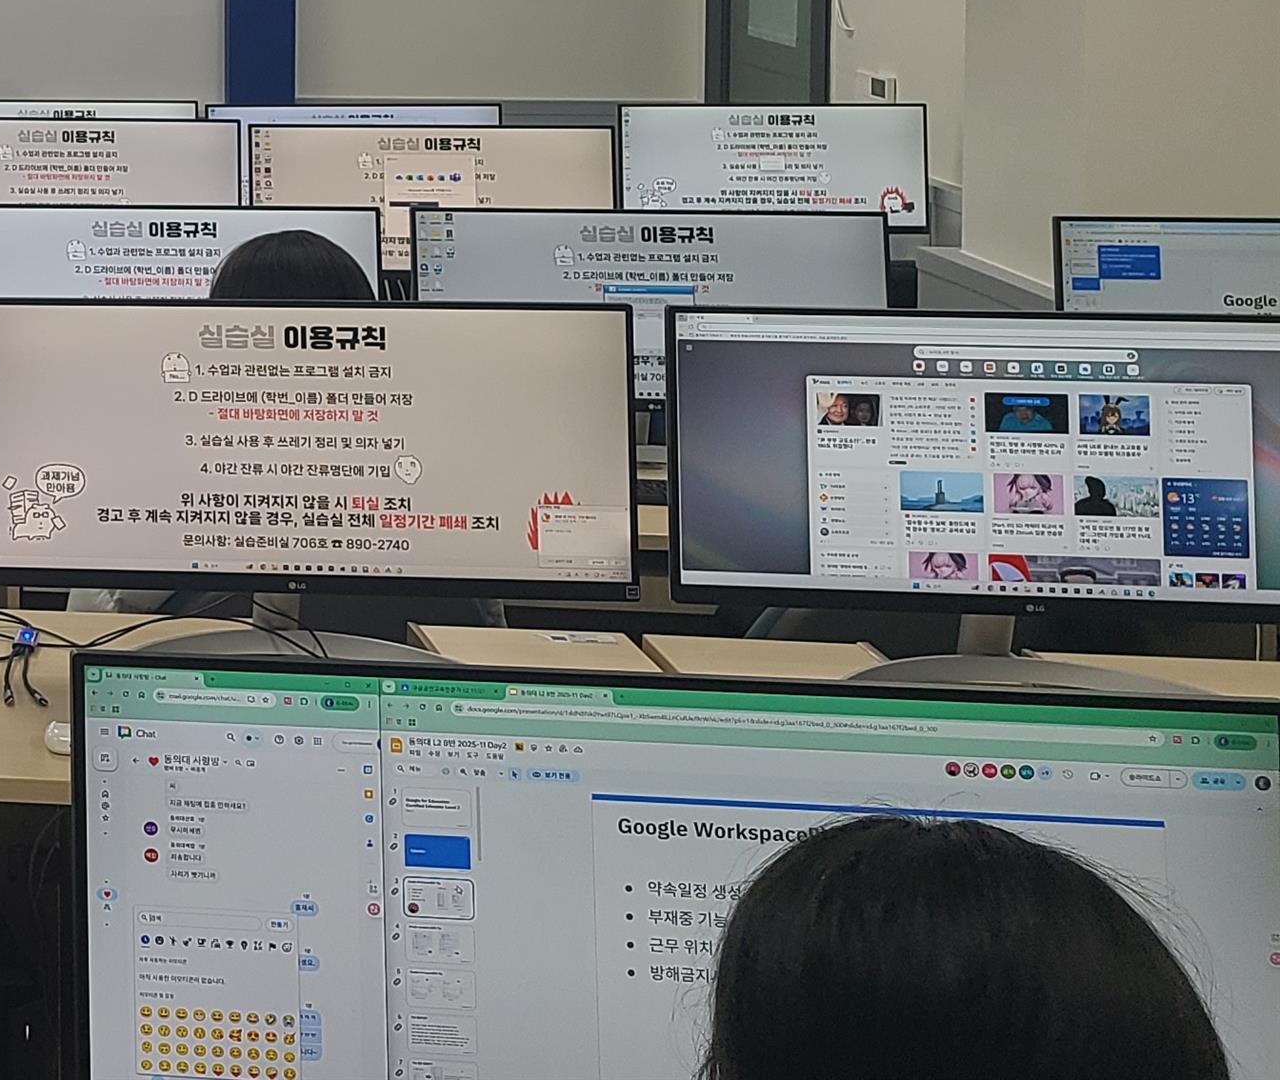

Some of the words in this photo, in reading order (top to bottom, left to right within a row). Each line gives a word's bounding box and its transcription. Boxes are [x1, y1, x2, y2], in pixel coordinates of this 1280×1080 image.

[92, 220, 143, 238] 실습실
[148, 221, 217, 239] 이용규칙
[580, 225, 635, 243] 실습실
[641, 226, 714, 244] 이용규칙
[1223, 294, 1278, 310] Google
[199, 325, 275, 349] 실습실
[284, 326, 386, 350] 이용규칙
[195, 365, 205, 376] 1.
[207, 365, 241, 376] 수업과
[244, 365, 290, 377] 관련없는
[293, 365, 339, 377] 프로그램
[342, 366, 365, 378] 설치
[368, 366, 391, 378] 금지
[174, 392, 186, 403] 2.
[188, 392, 198, 402] D
[200, 392, 258, 403] 드라이브에
[326, 393, 349, 405] 폴더
[351, 393, 386, 405] 만들어
[390, 394, 412, 406] 저장
[217, 408, 240, 420] 절대
[243, 409, 300, 421] 바탕화면에
[303, 409, 349, 422] 저장하지
[352, 410, 363, 422] 말
[367, 410, 379, 422] 것
[180, 494, 194, 508] 위
[198, 494, 239, 508] 사항이
[243, 494, 298, 509] 지켜지지
[302, 495, 330, 510] 않을
[334, 496, 348, 511] 시
[351, 496, 380, 511] 퇴실
[383, 496, 411, 512] 조치
[96, 508, 125, 523] 경고
[127, 509, 142, 523] 후
[145, 509, 172, 524] 계속
[176, 509, 231, 525] 지켜지지
[234, 510, 262, 526] 않을
[265, 511, 298, 528] 경우,
[302, 512, 344, 528] 실습실
[347, 513, 375, 529] 전체
[379, 513, 435, 530] 일정기간
[438, 514, 468, 530] 폐쇄
[471, 515, 500, 532] 조치
[183, 535, 231, 548] 문의사항:
[234, 535, 290, 549] 실습준비실
[292, 535, 329, 550] 706호
[346, 538, 410, 552] 890-2740
[136, 729, 157, 739] Chat
[408, 737, 432, 747] 동의대
[433, 739, 442, 747] L2
[457, 740, 487, 749] 2025-11
[487, 741, 507, 750] Day2
[164, 753, 190, 765] 동의대
[618, 818, 688, 840] Google
[648, 881, 707, 899] 약속일정
[648, 909, 694, 927] 부재중
[649, 937, 679, 953] 근무
[684, 939, 714, 956] 위치
